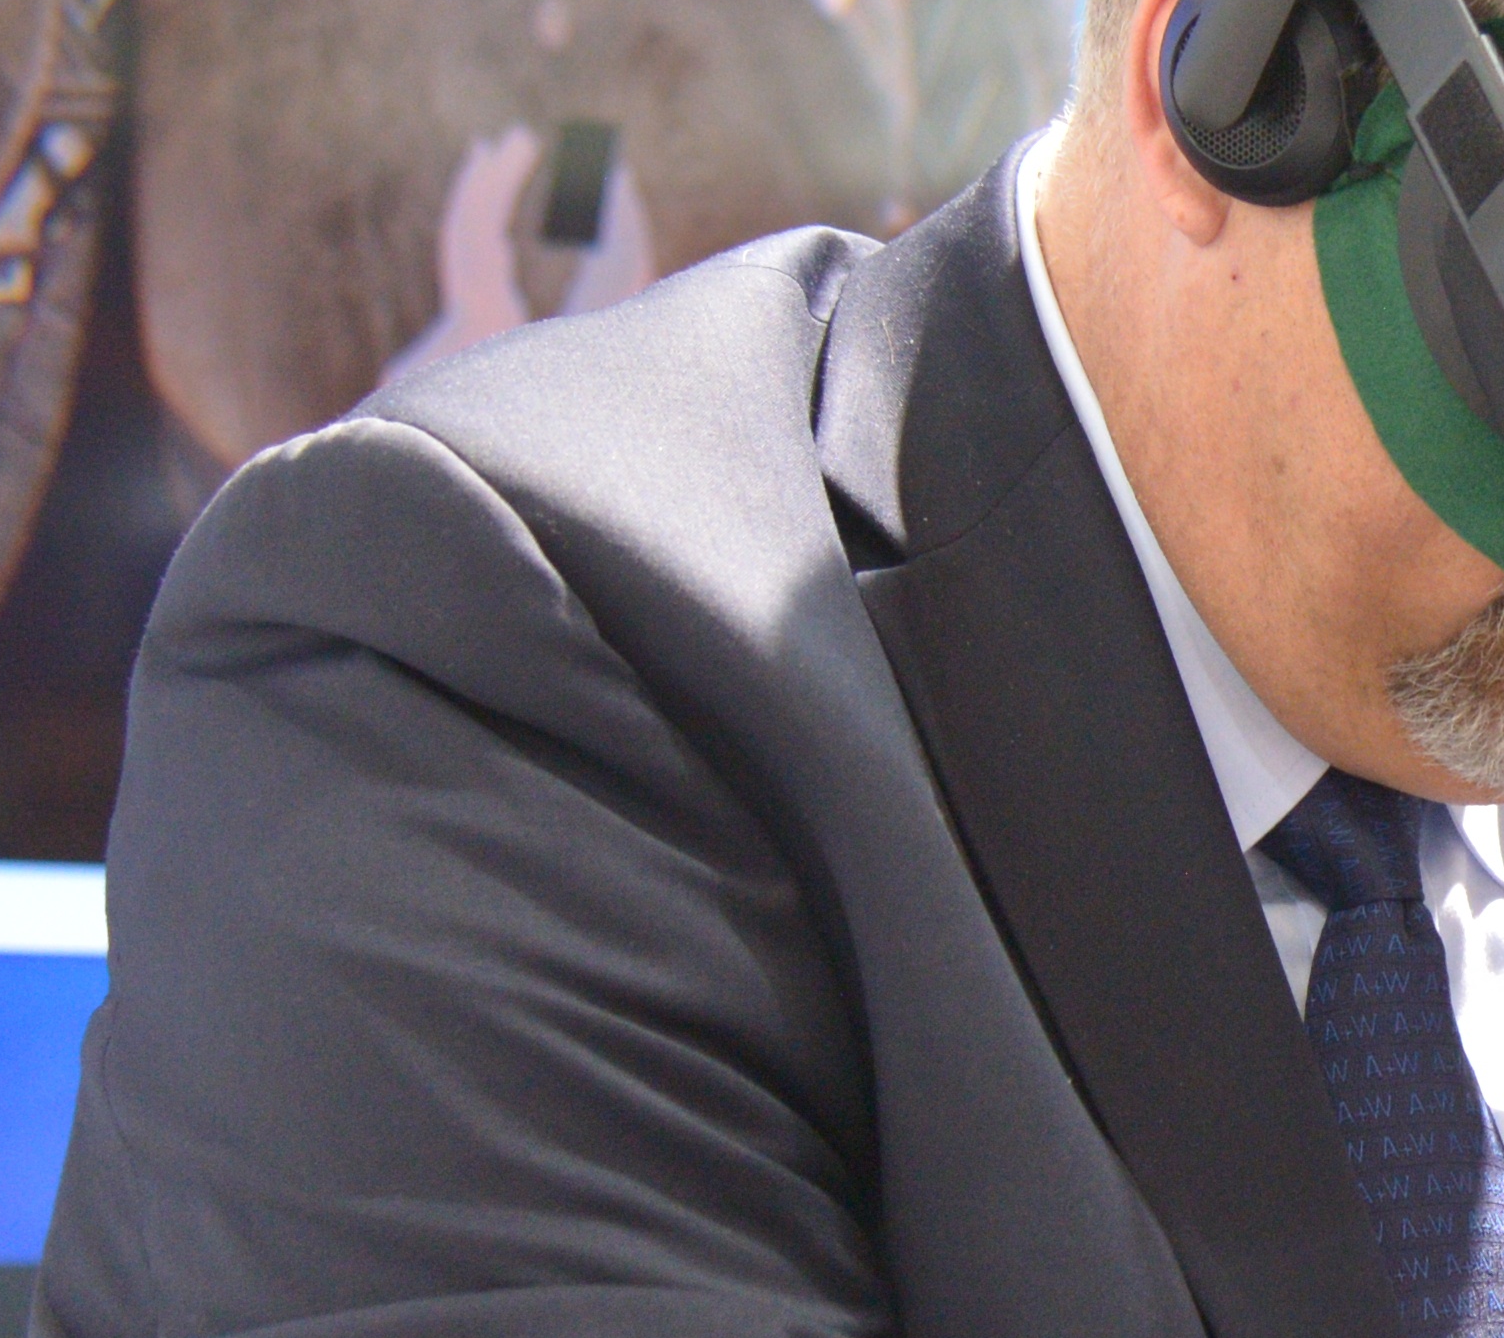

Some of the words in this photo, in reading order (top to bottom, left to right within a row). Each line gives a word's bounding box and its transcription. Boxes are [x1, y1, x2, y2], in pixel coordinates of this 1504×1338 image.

[1353, 971, 1410, 997] A+W
[1324, 1013, 1377, 1042] A+W
[1366, 1051, 1418, 1078] A+W
[1338, 1094, 1391, 1124] A+W
[1383, 1132, 1434, 1159] A+W
[1402, 1213, 1453, 1239] A+W
[1395, 1256, 1429, 1281] +W
[1423, 1291, 1475, 1321] A+W
